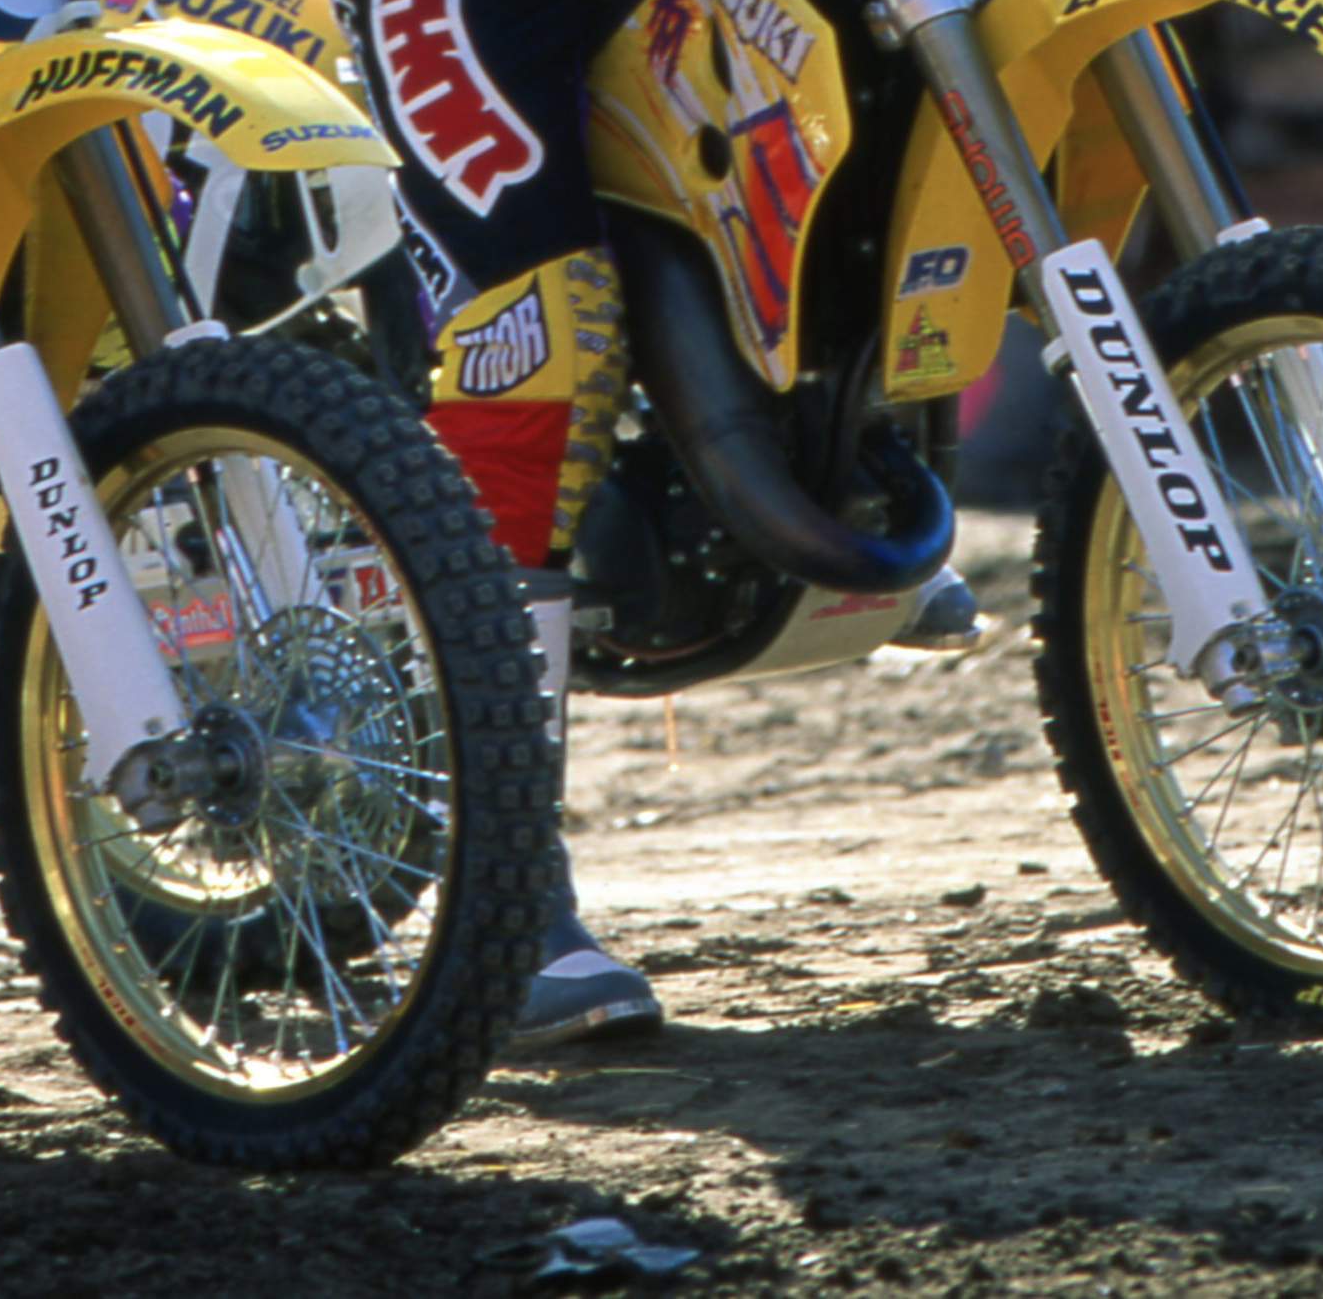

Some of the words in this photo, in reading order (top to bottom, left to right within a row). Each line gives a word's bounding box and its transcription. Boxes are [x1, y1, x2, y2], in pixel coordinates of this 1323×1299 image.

[14, 49, 245, 139] HUFFMAN
[260, 123, 377, 152] SUZUKI
[453, 291, 548, 397] THOR
[1060, 266, 1232, 572] DUNLOP
[30, 458, 107, 608] DUNLOP
